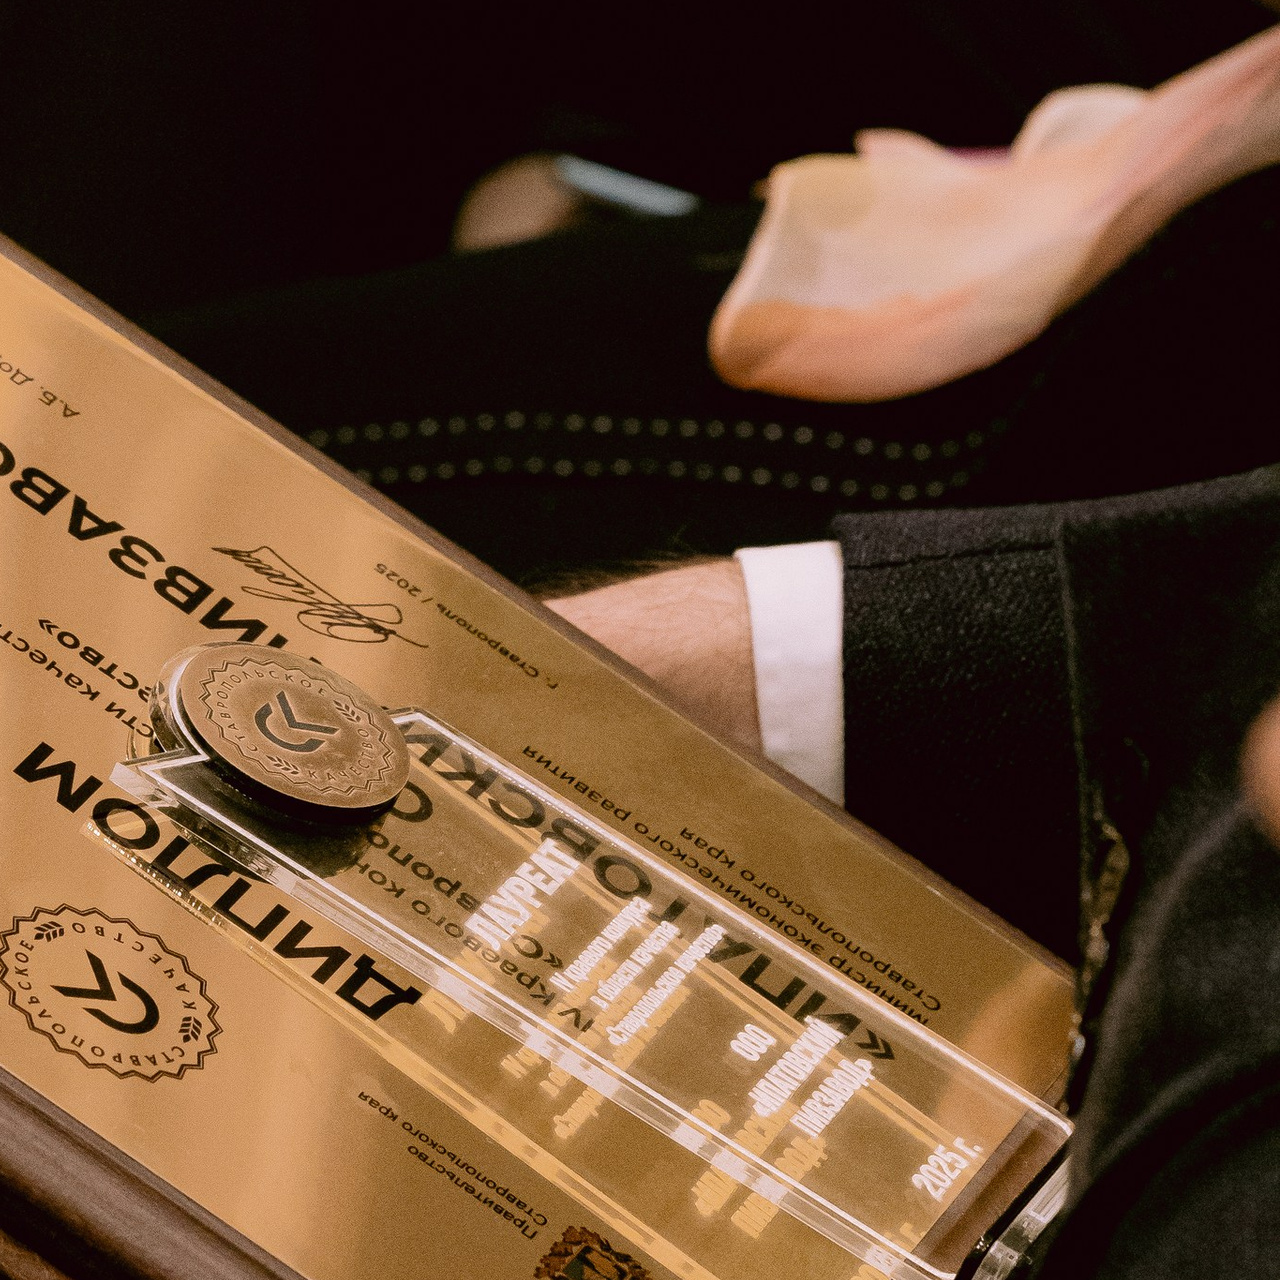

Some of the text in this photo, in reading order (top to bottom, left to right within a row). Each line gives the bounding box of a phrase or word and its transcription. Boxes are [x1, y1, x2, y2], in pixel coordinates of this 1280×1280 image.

[38, 387, 81, 418] А.Б.
[374, 562, 422, 597] 2025
[437, 603, 540, 678] Ставрополь
[216, 670, 326, 752] СТАВРОПОЛЬСКОЕ
[309, 728, 373, 782] КАЧЕСТВО
[523, 747, 631, 821] развития
[14, 743, 422, 1020] ДИПЛОМ
[398, 721, 896, 1061] «ИПАТОВСКИ
[635, 823, 823, 954] экономического
[680, 828, 941, 1011] Ставропольского края
[72, 923, 196, 1009] КАЧЕСТВО
[411, 899, 555, 1006] Краевого
[15, 941, 185, 1066] СТАВРОПОЛЬСКОЕ
[359, 1092, 547, 1226] Ставропольского края
[408, 1146, 537, 1239] Правительство
